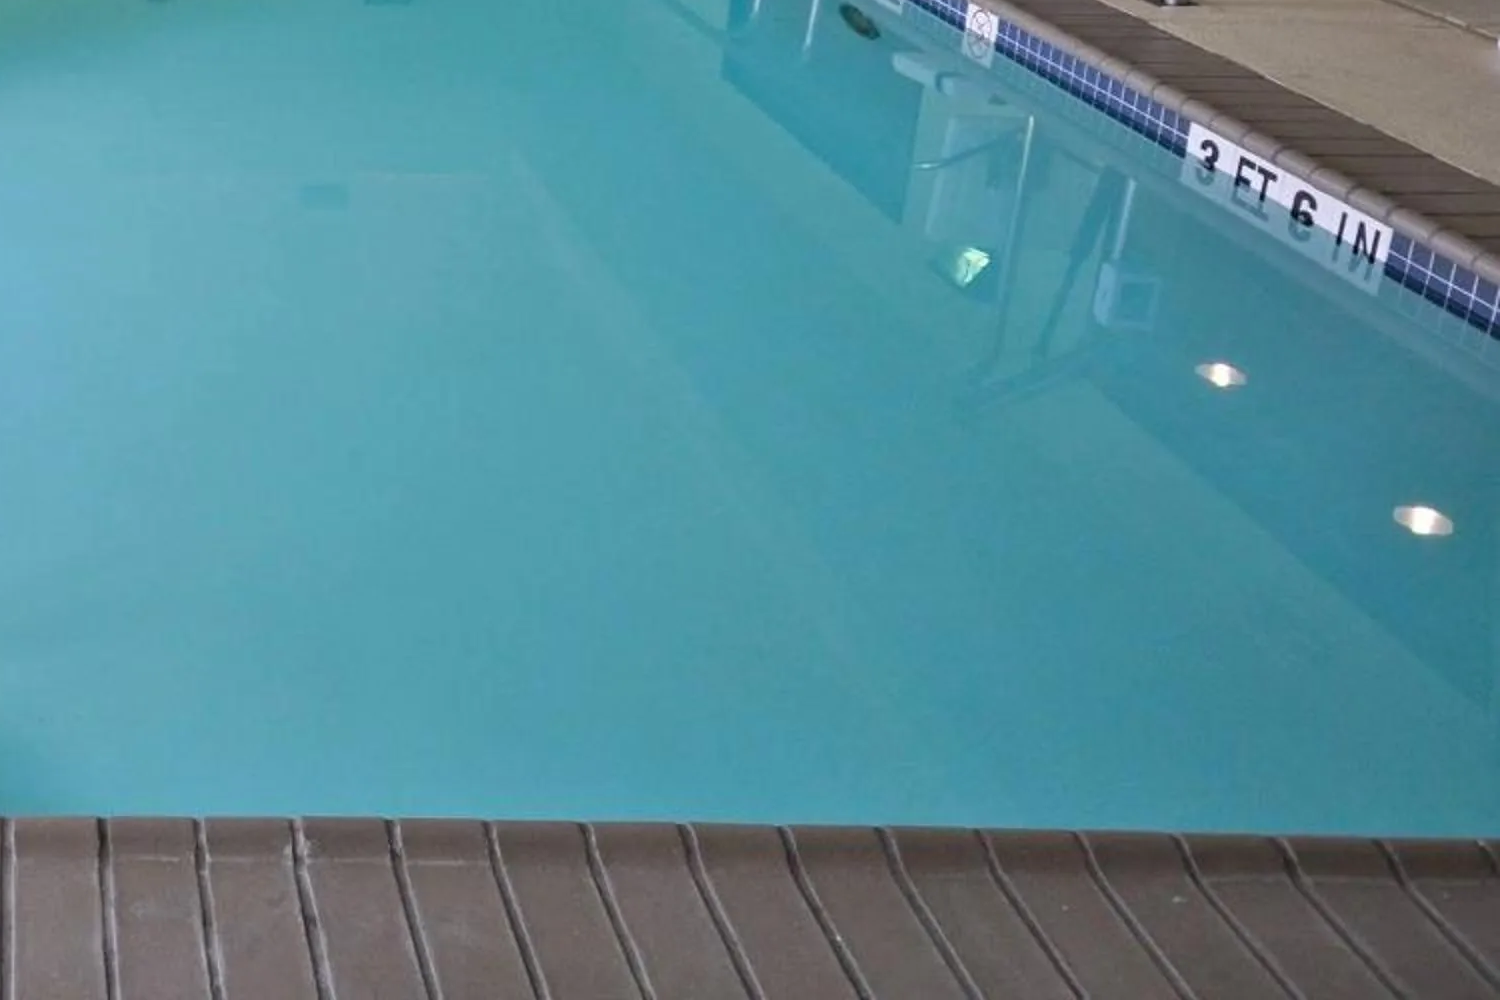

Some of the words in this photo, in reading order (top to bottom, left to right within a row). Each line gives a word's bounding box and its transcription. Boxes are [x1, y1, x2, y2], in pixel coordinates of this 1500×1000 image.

[1201, 139, 1219, 173] 3
[1234, 155, 1278, 202] FT
[1290, 189, 1318, 227] 6
[1336, 211, 1381, 264] IN
